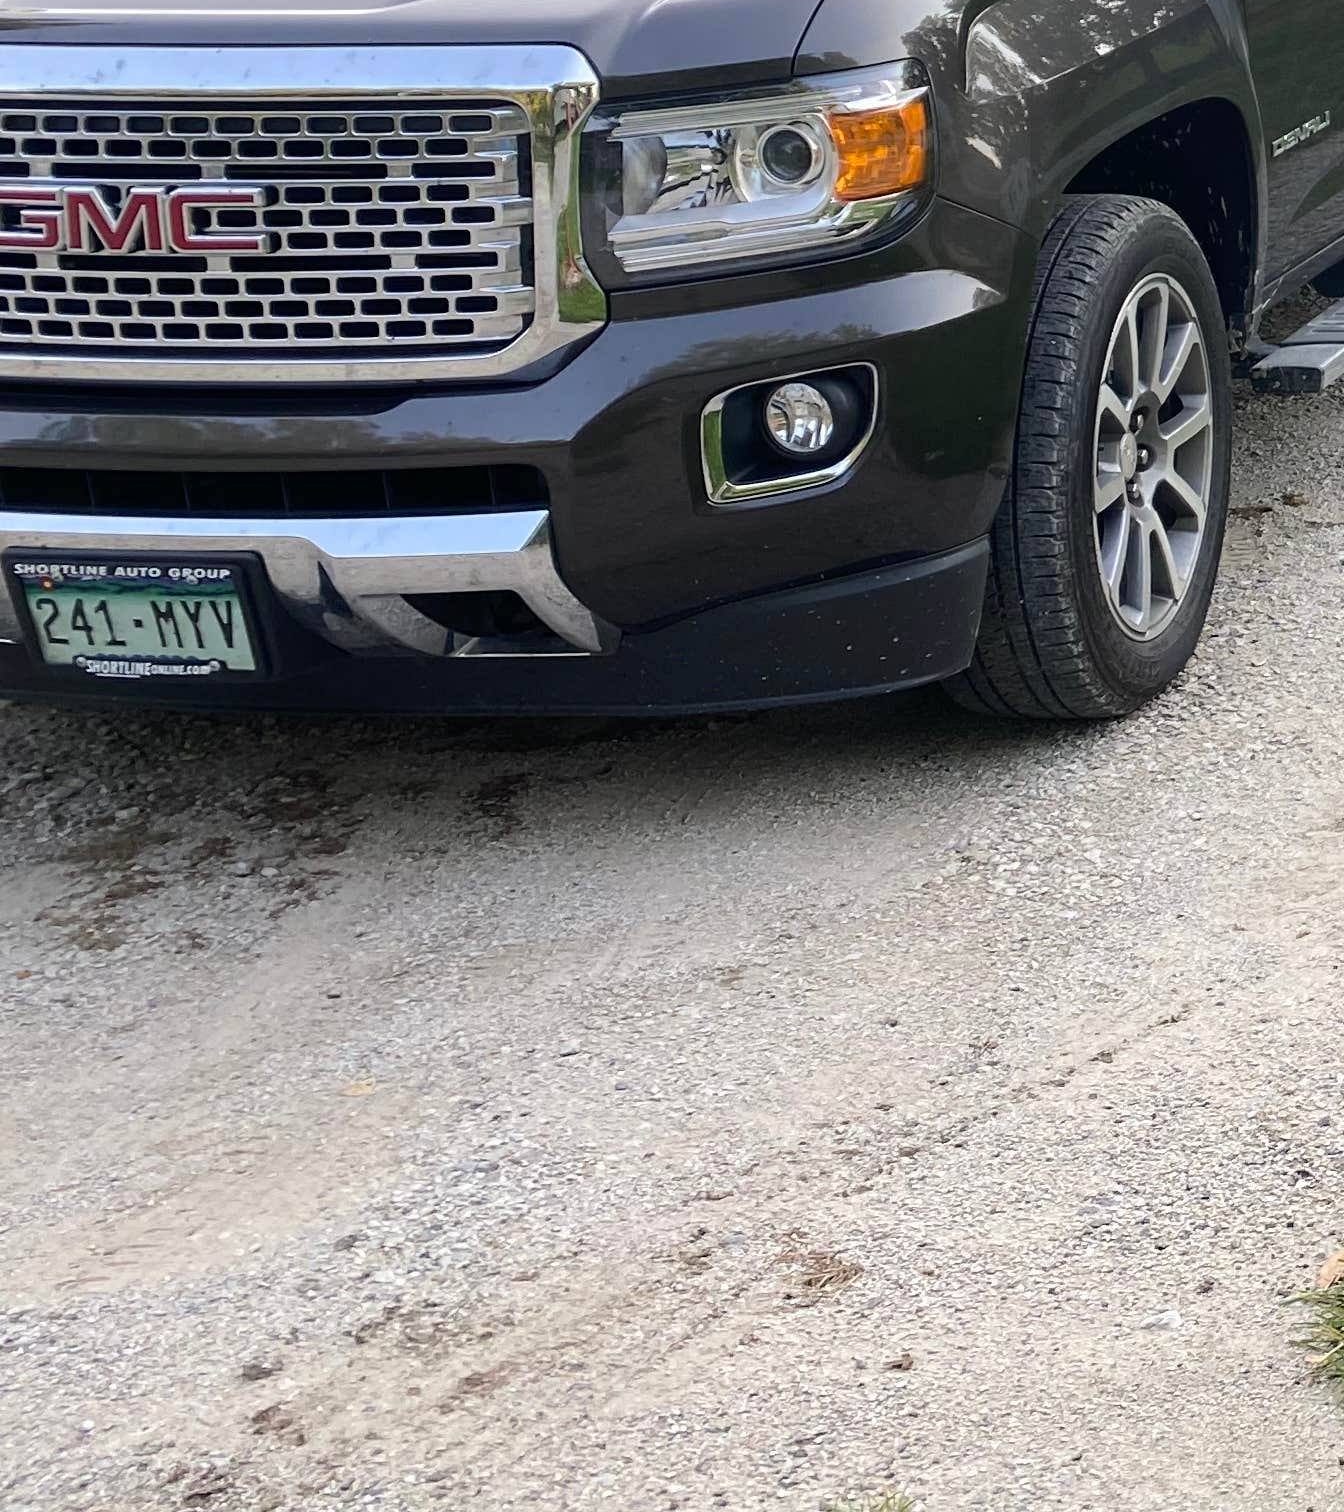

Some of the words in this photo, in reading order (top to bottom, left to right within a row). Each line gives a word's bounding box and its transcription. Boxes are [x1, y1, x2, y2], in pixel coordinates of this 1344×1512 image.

[1271, 110, 1331, 158] DENALI
[0, 186, 266, 253] GMC
[13, 563, 107, 576] SHORTLINE
[114, 566, 161, 578] AUTO
[168, 568, 231, 579] GROUP
